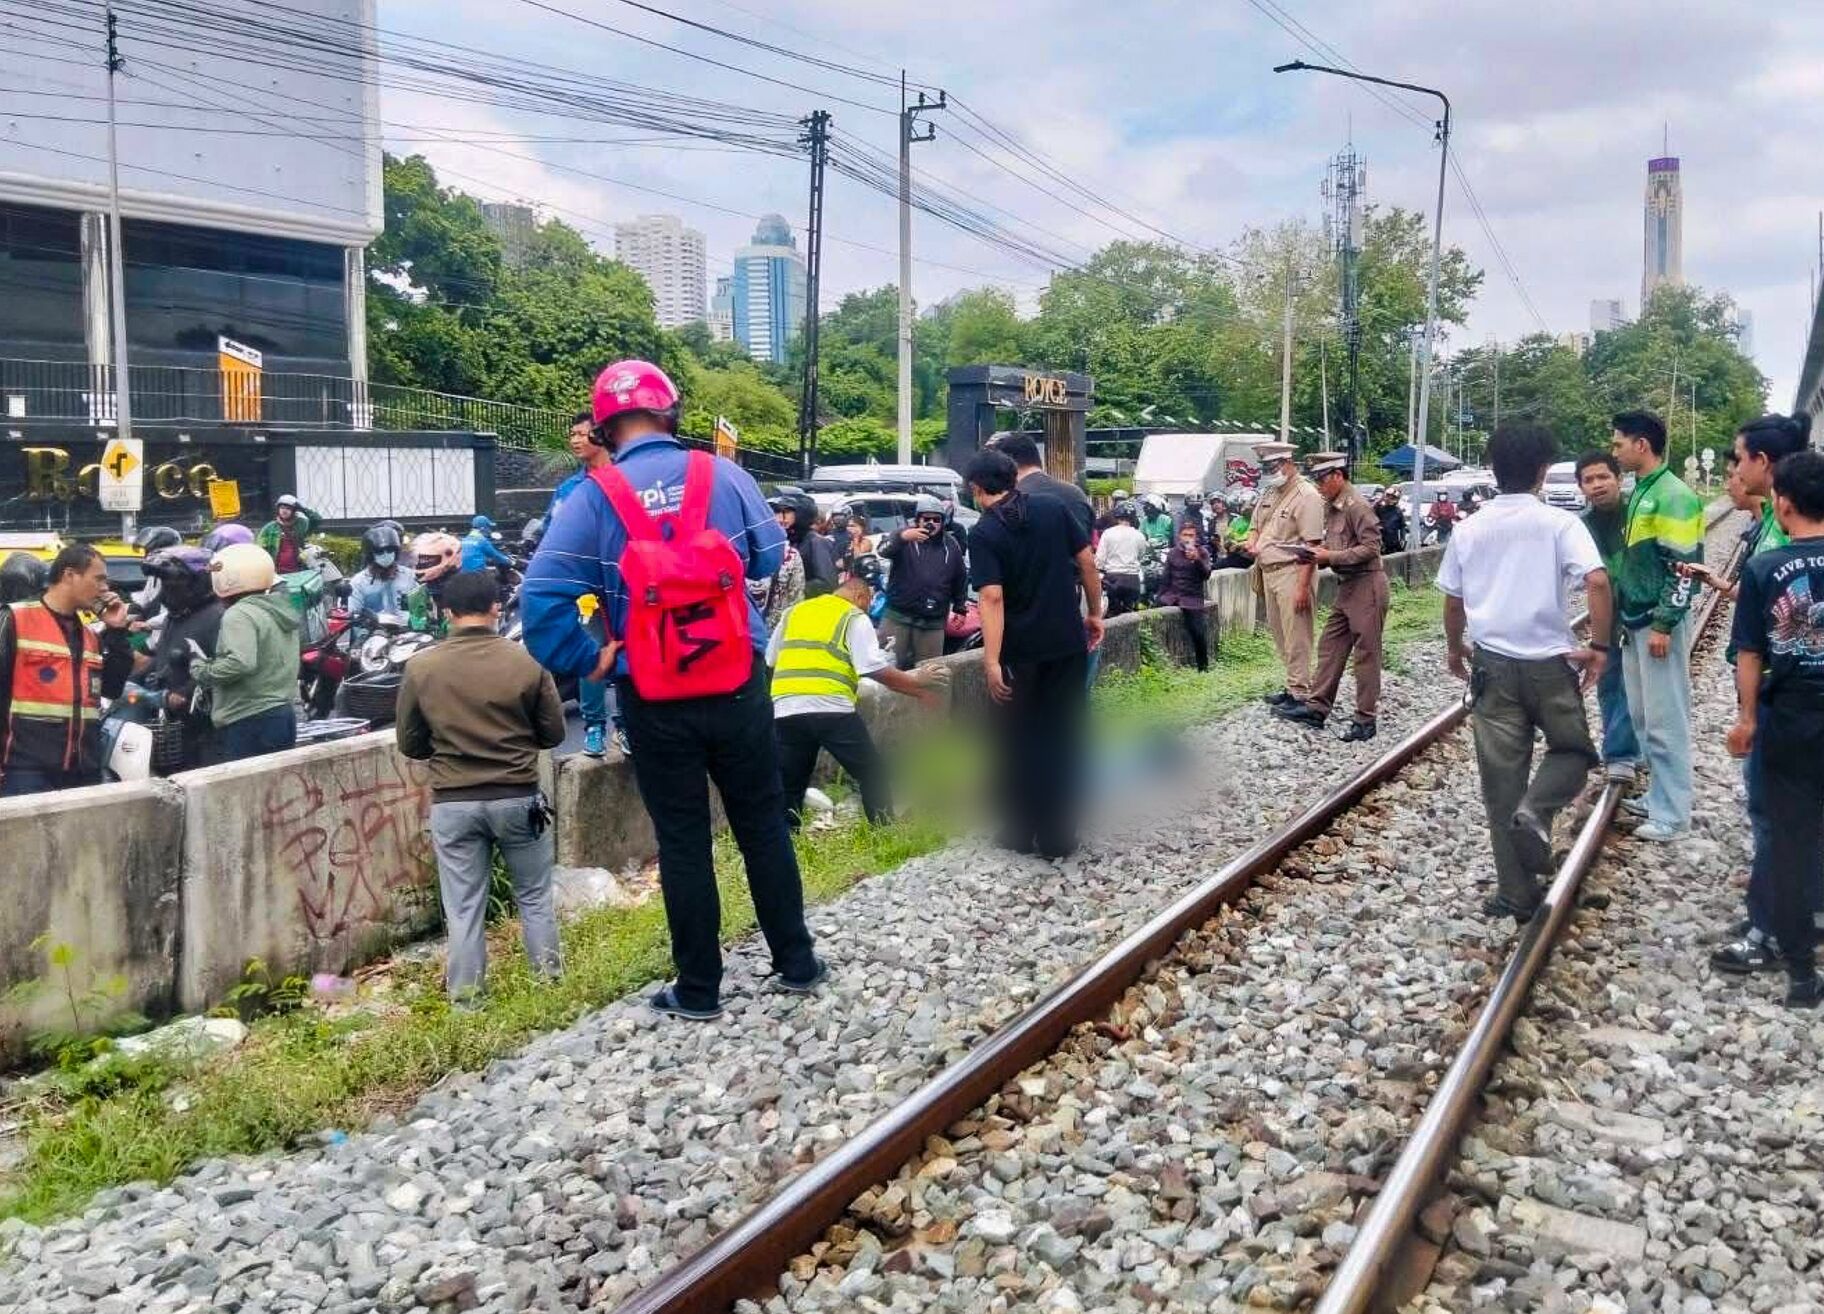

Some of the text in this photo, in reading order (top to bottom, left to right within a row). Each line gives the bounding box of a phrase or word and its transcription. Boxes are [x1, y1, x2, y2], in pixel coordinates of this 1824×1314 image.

[1024, 376, 1067, 404] ROYCE
[20, 447, 220, 499] Roce
[1773, 558, 1805, 582] LIVE
[1671, 577, 1692, 607] Gra
